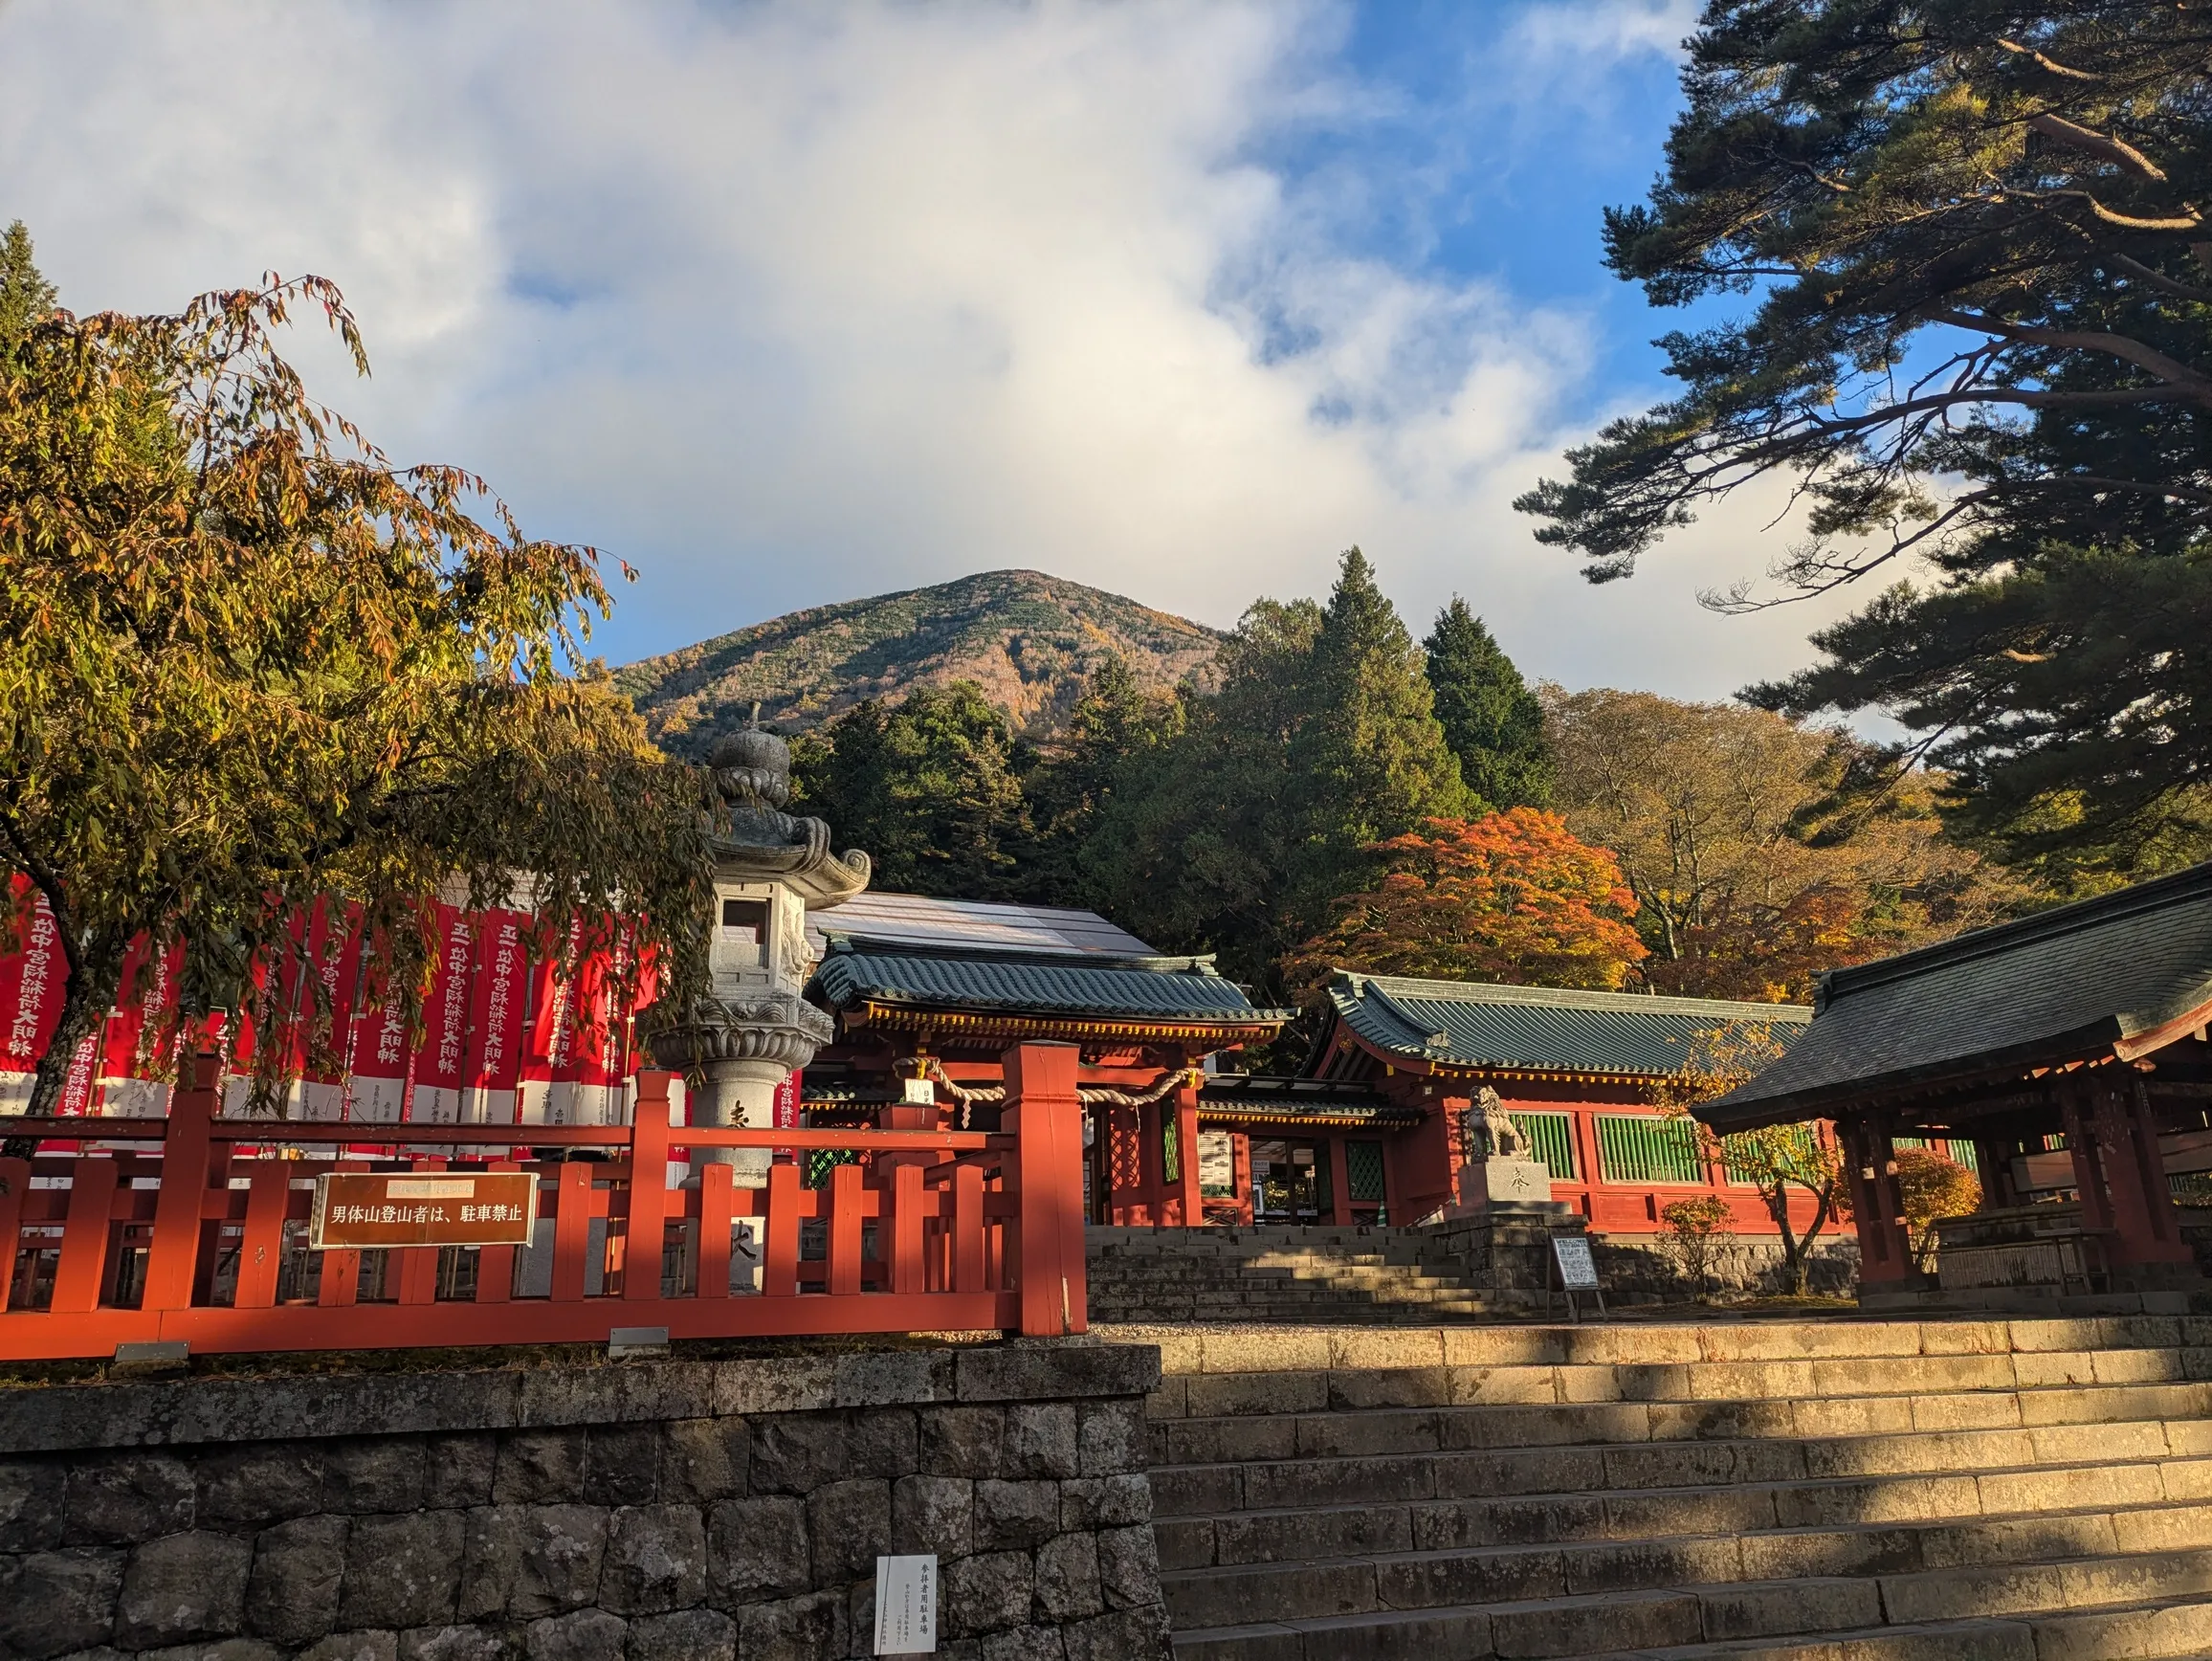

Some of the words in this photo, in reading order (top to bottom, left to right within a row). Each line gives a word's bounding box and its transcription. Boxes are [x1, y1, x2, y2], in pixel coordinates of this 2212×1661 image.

[1509, 1167, 1530, 1193] 奉
[331, 1205, 522, 1224] 男体山登山者は、駐車禁止
[918, 1562, 930, 1635] 参拝者用駐車場
